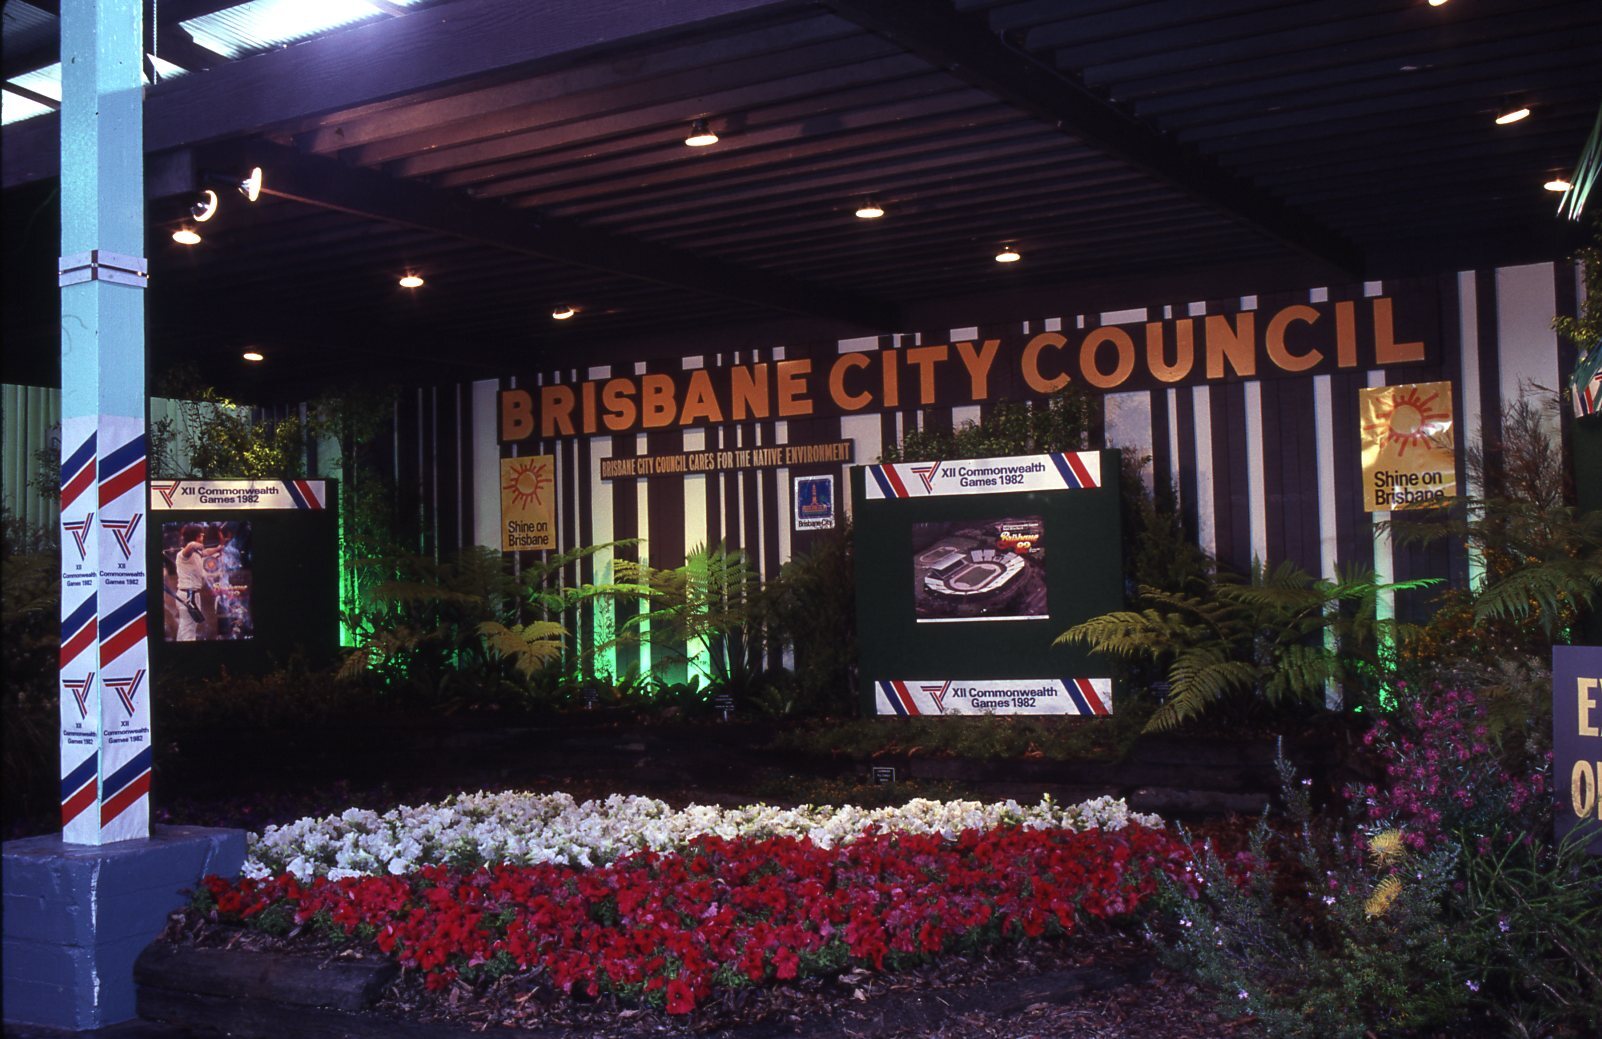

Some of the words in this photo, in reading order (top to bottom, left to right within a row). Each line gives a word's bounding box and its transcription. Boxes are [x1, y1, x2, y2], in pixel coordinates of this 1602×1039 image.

[502, 358, 814, 441] BRISBANE
[829, 339, 1000, 411] CITY
[1022, 298, 1425, 394] COUNCIL
[602, 459, 636, 477] BRISBANE
[637, 457, 654, 474] CITY
[655, 455, 687, 473] COUNCIL
[689, 452, 715, 471] CARES
[717, 452, 733, 469] FOR
[735, 450, 751, 467] THE
[753, 448, 783, 466] NATIVE
[785, 442, 850, 464] ENVIRONMENT
[941, 468, 956, 478] XII
[958, 462, 1045, 477] Commonwealth
[960, 478, 997, 487] Games
[999, 474, 1024, 485] 1982
[1375, 470, 1419, 487] Shine
[1423, 472, 1442, 484] on
[181, 487, 195, 495] XII
[198, 486, 279, 495] Commonwealth
[1375, 487, 1444, 505] Brisbane
[200, 495, 235, 503] Games
[238, 495, 259, 503] 1982
[508, 521, 535, 533] Shine
[536, 522, 548, 531] on
[508, 534, 549, 546] Brisbane
[952, 688, 966, 697] XII
[968, 686, 1058, 698] Commonwealth
[971, 698, 1010, 708] Games
[1011, 698, 1036, 708] 1982
[1577, 676, 1602, 737] E
[103, 727, 149, 736] Commonwealth
[129, 735, 143, 743] 1982
[1571, 759, 1602, 820] O
